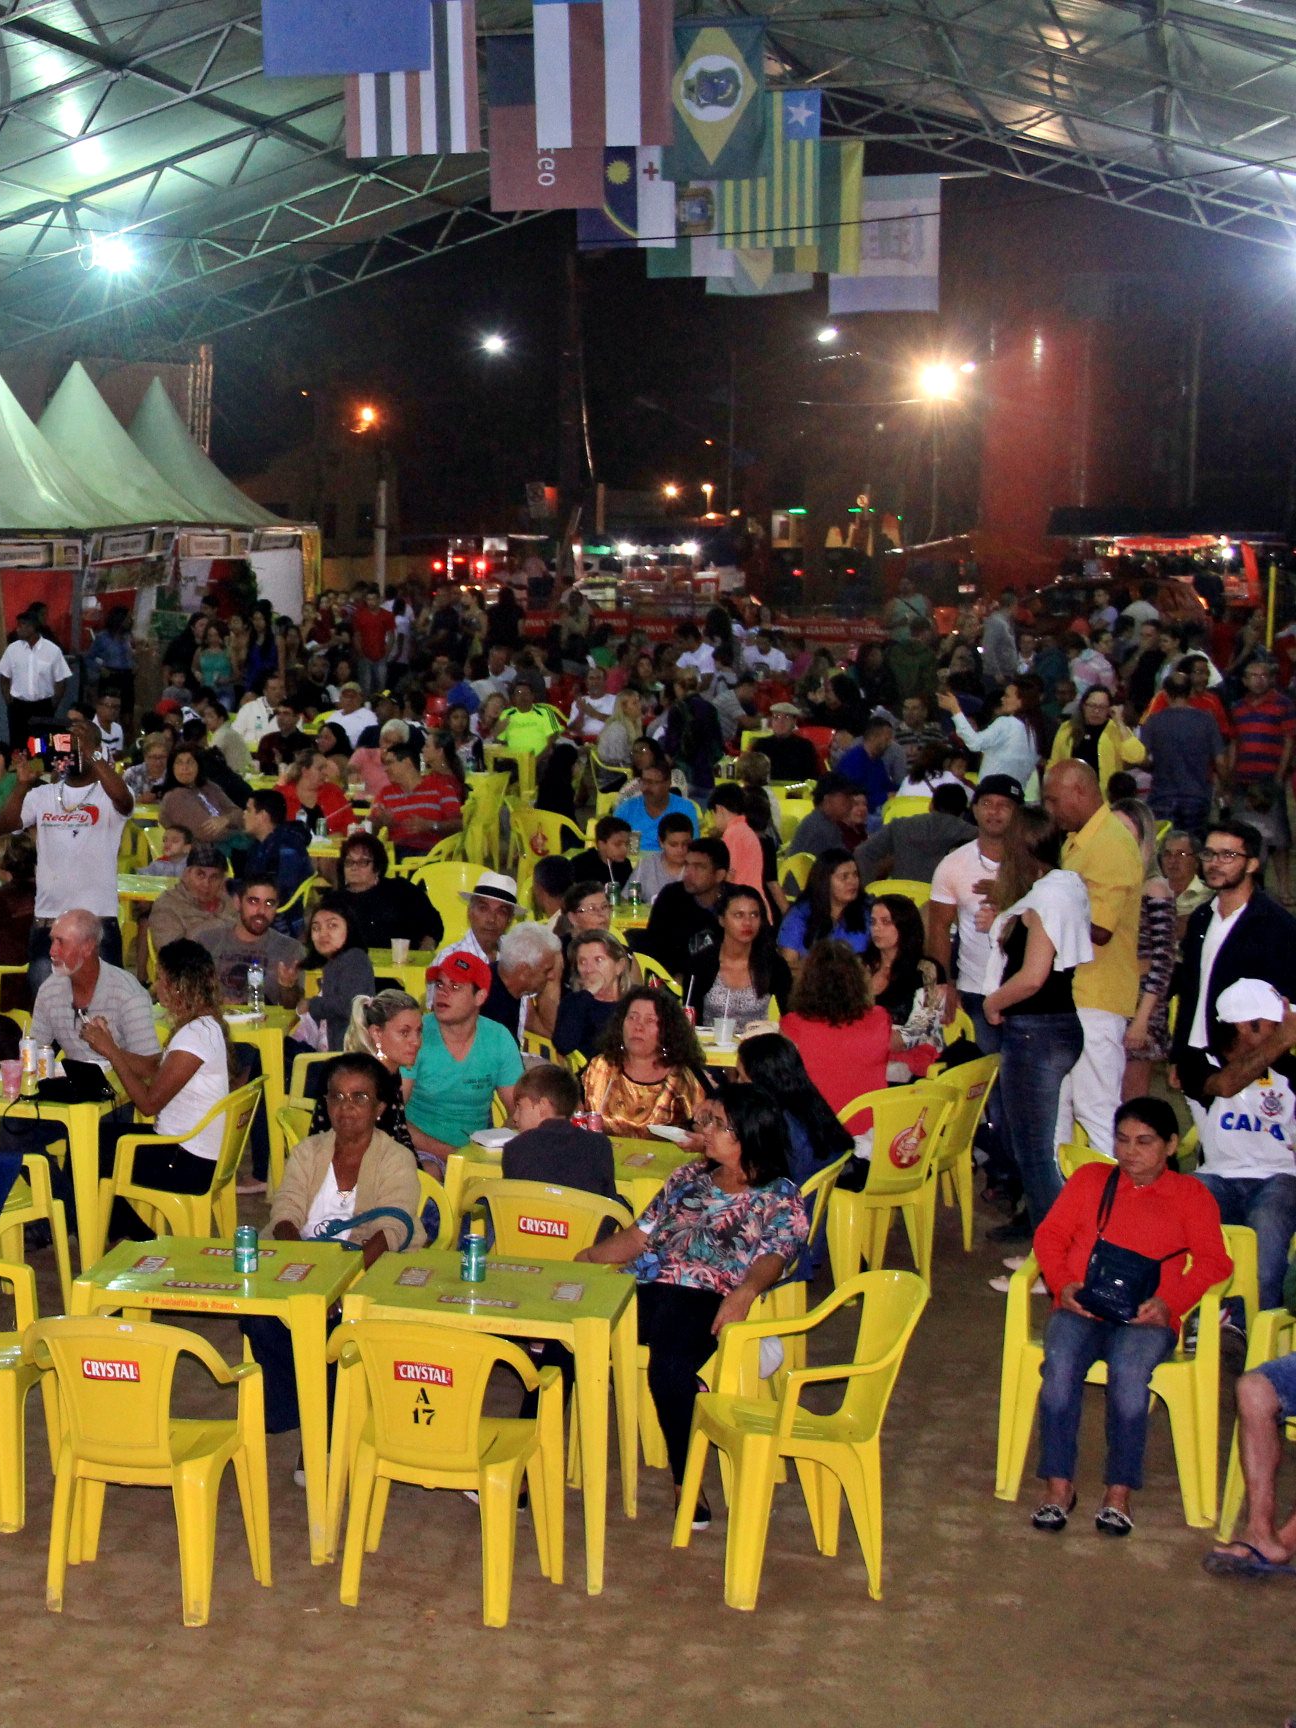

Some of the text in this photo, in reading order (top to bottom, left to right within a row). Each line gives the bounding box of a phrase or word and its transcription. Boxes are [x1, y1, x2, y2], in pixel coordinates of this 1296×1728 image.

[42, 812, 90, 823] RedFly
[1220, 1112, 1285, 1141] CAIA
[520, 1217, 566, 1236] CRYSTAL
[83, 1360, 137, 1379] CRYSTAL
[399, 1364, 448, 1384] CRYSTAL
[416, 1387, 430, 1405] A
[412, 1407, 435, 1425] 17
